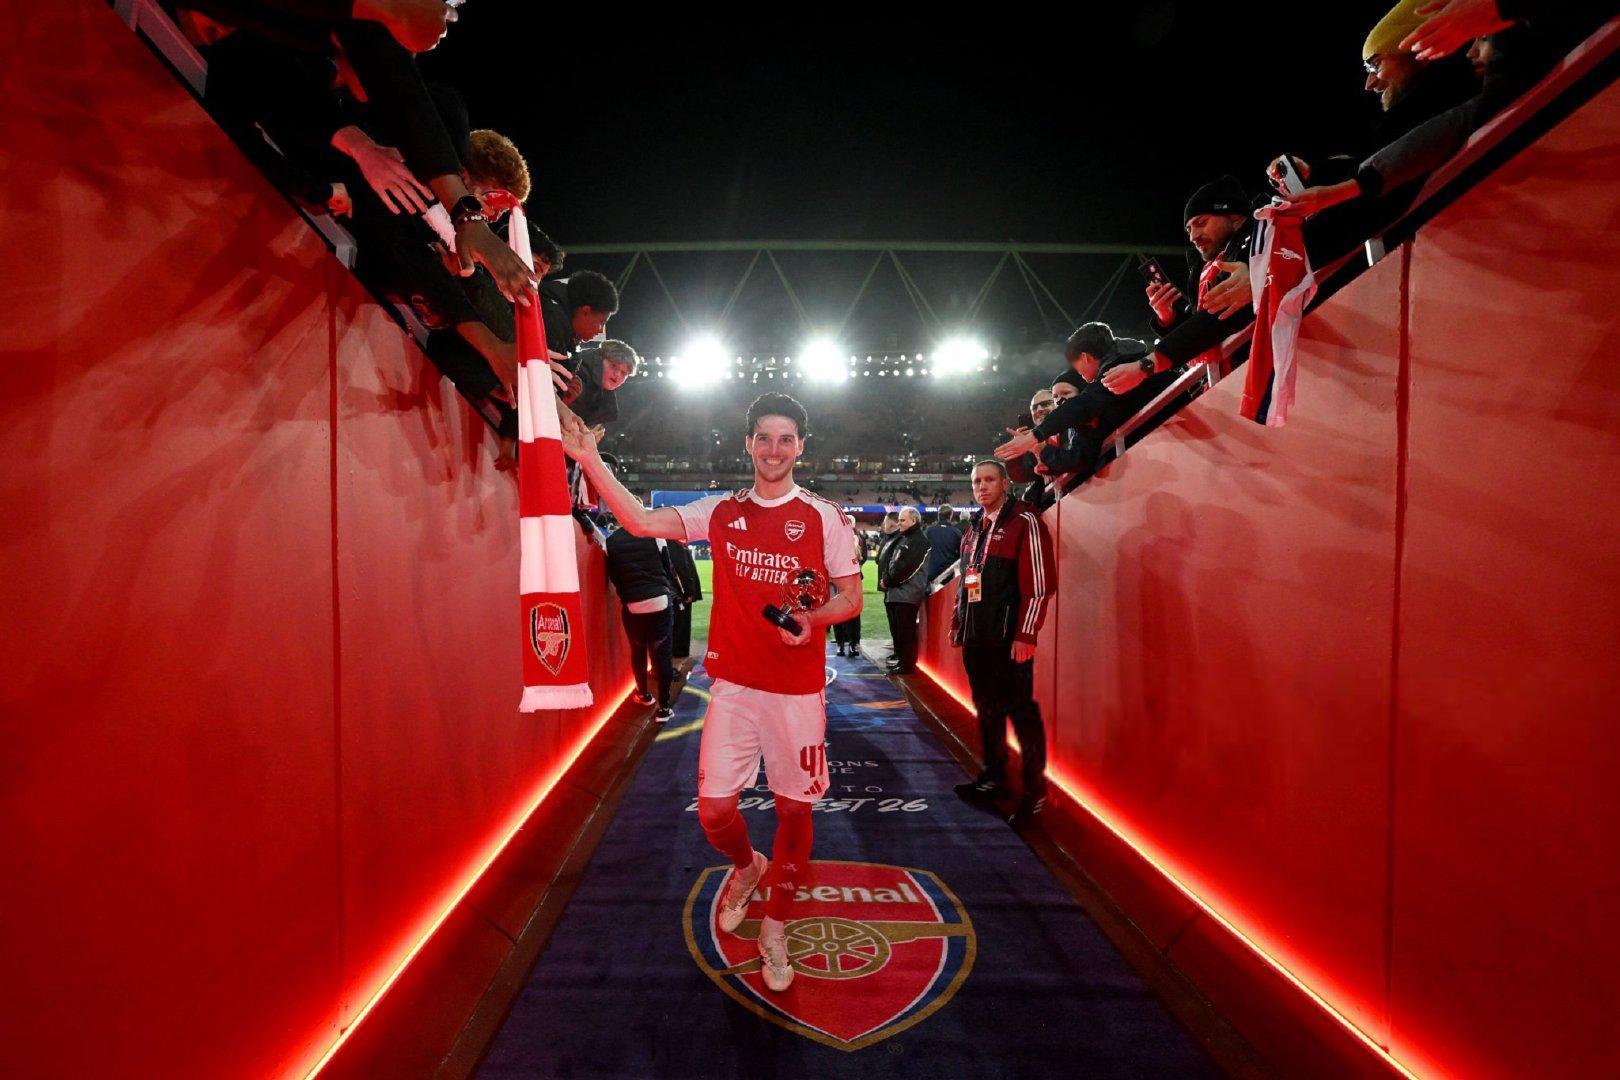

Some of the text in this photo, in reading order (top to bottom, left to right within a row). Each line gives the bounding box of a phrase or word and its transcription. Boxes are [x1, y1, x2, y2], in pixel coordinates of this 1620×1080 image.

[726, 541, 801, 570] Emirates
[735, 563, 788, 585] FLY BETTER
[800, 743, 824, 778] 41
[841, 785, 883, 793] TO
[877, 798, 929, 813] 26
